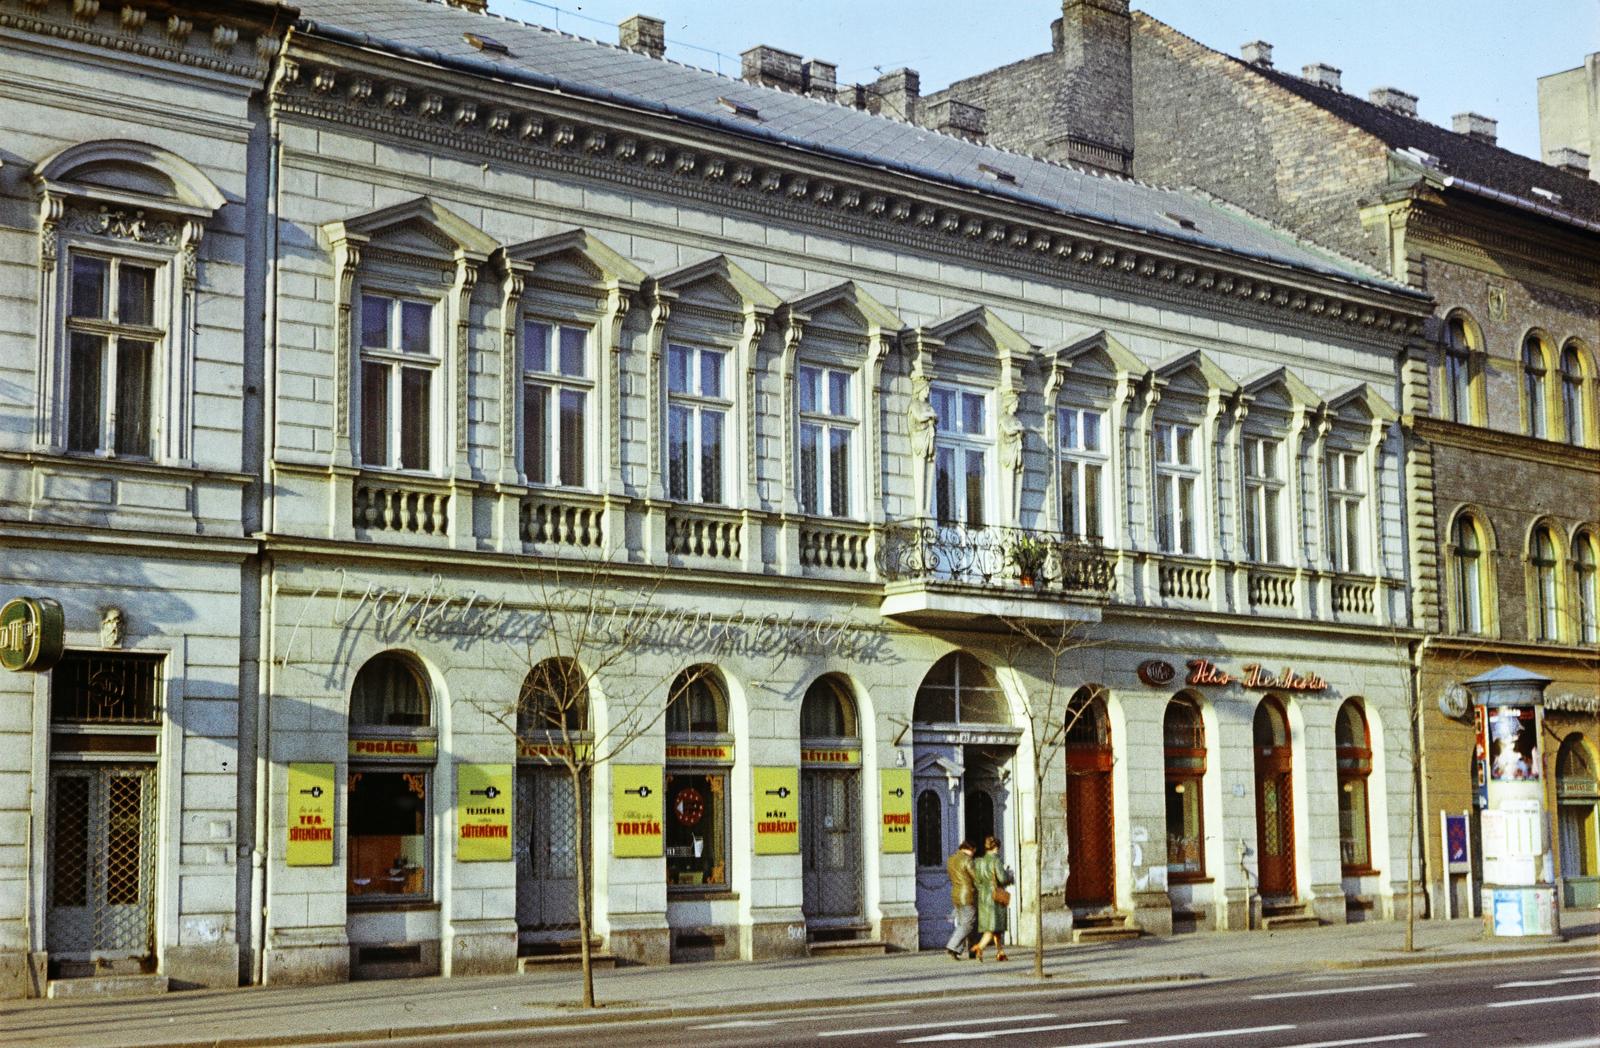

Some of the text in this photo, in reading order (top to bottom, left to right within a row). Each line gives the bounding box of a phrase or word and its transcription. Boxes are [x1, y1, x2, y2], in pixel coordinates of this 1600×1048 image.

[356, 740, 418, 754] POGÁCSA
[766, 810, 787, 818] HÁZI
[289, 825, 332, 842] SÜTEMÉNYEK
[460, 823, 509, 838] SÜTEMÉNYEK
[616, 820, 661, 835] TORTÁK
[757, 820, 797, 834] CUKRÁSZAT
